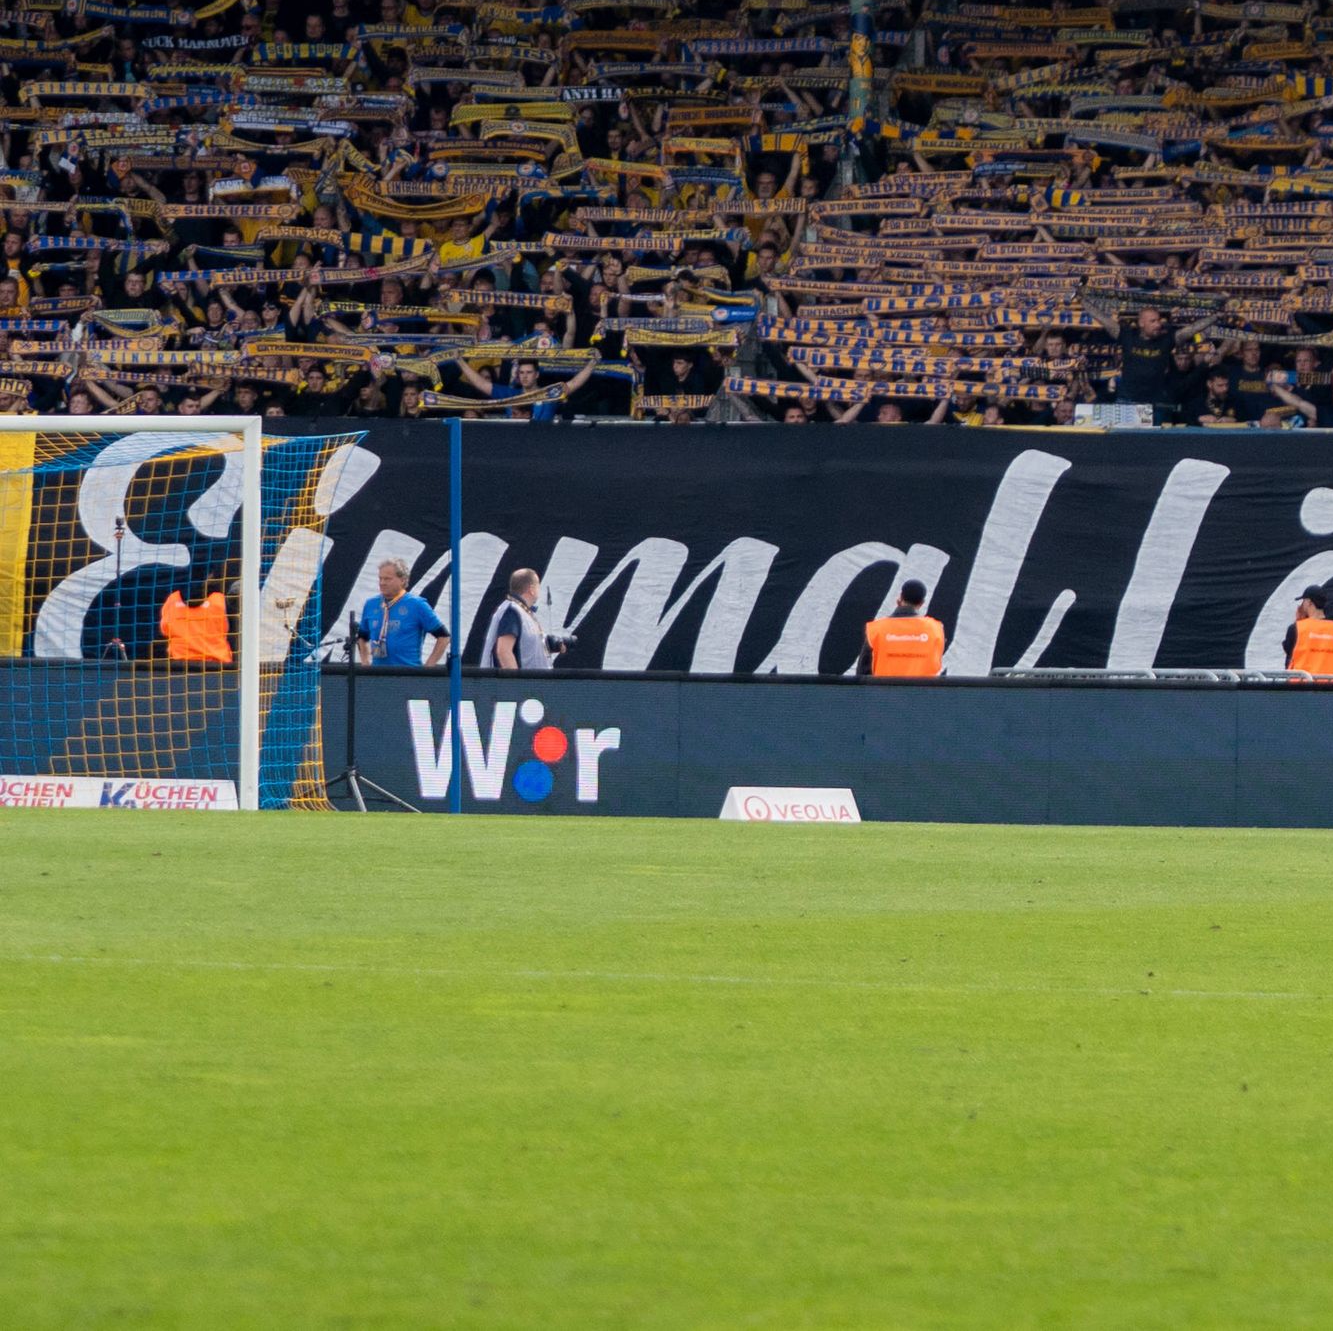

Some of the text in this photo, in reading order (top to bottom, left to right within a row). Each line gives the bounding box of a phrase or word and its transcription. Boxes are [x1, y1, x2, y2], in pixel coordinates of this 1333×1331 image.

[38, 82, 139, 95] EINTRACHT
[563, 88, 598, 100] ANTI
[1001, 244, 1029, 256] STADT
[109, 352, 216, 364] EINTRACHT
[774, 803, 853, 820] VEOLIA
